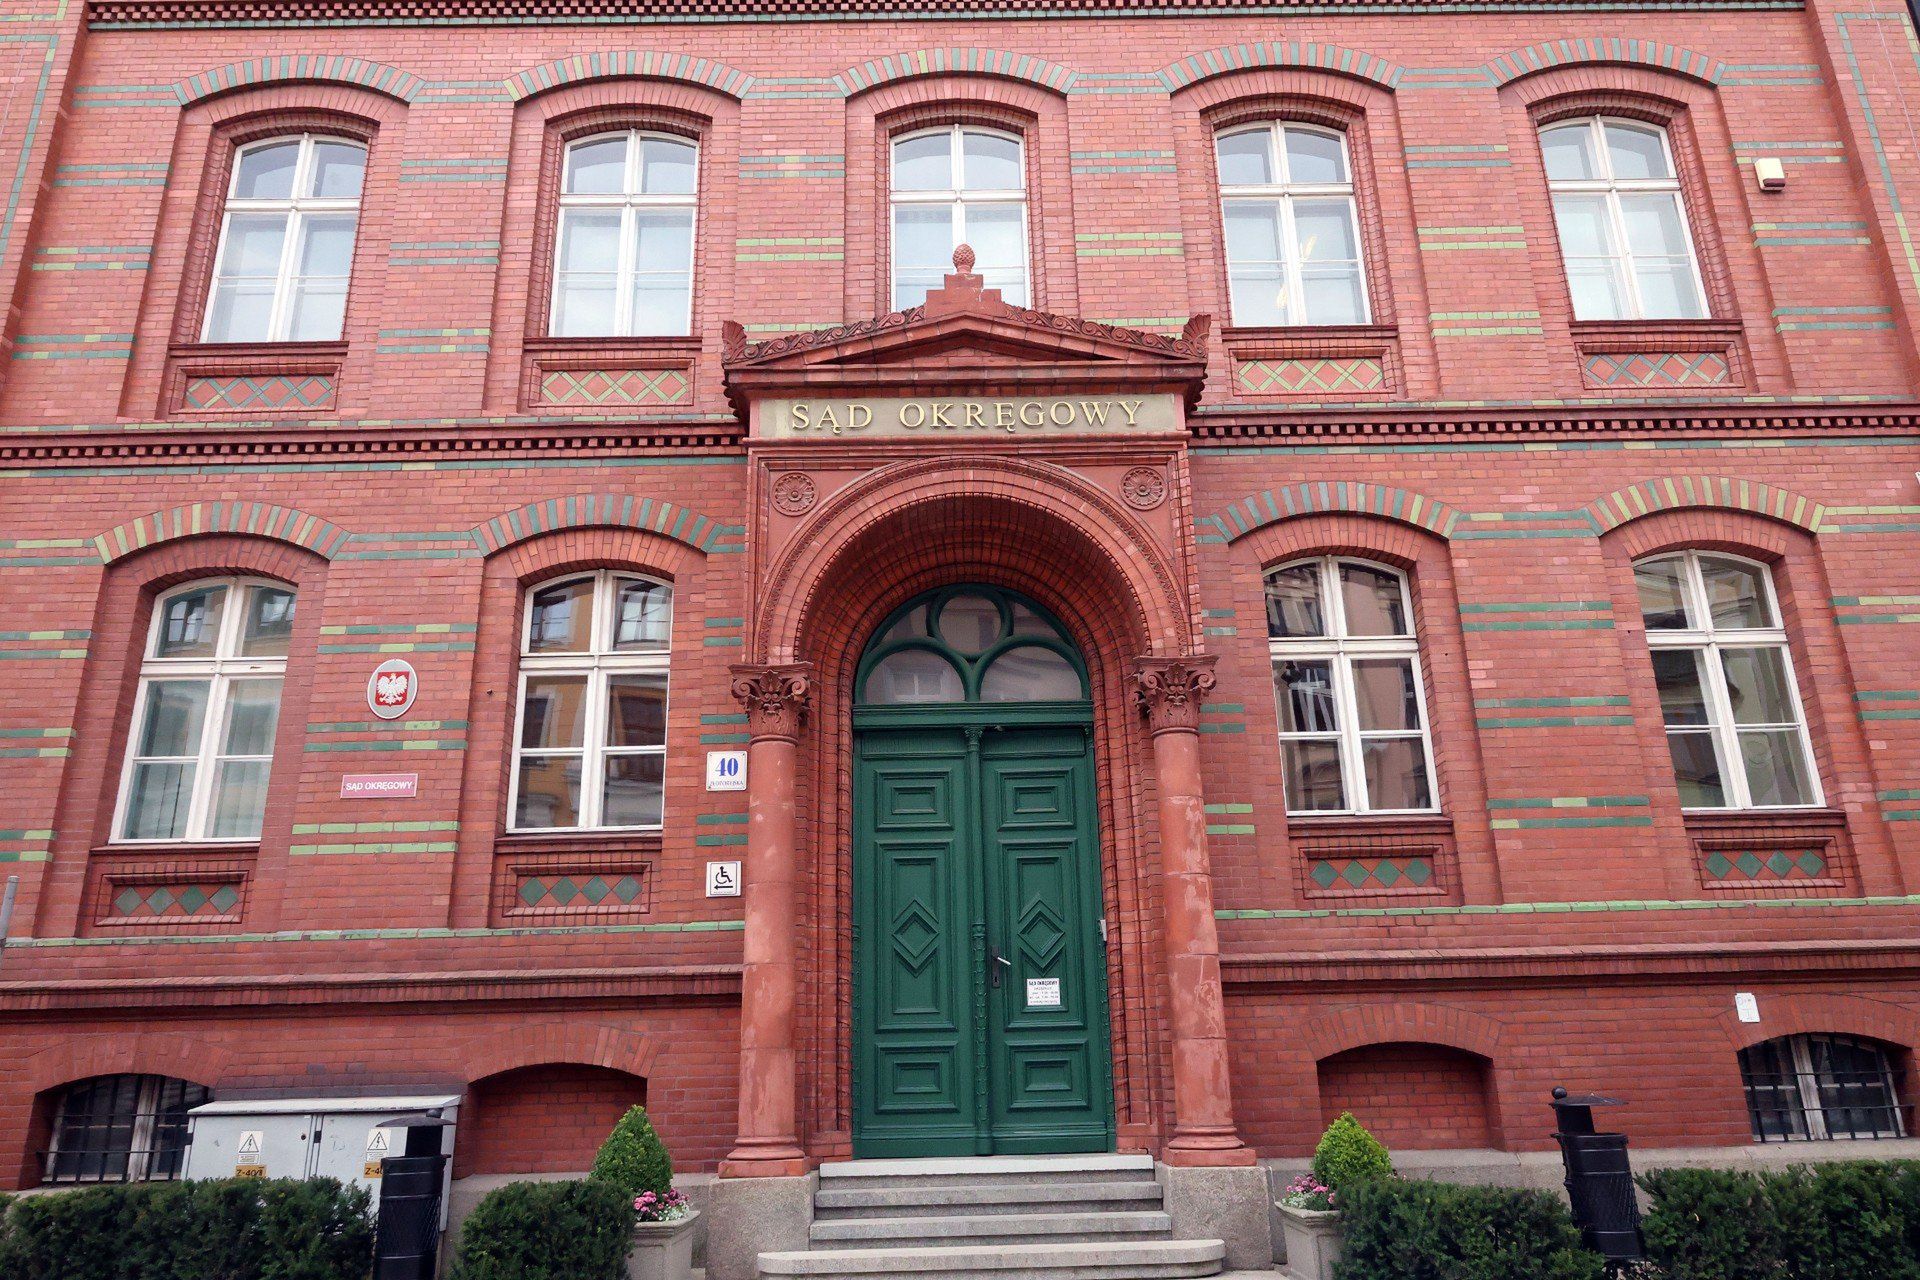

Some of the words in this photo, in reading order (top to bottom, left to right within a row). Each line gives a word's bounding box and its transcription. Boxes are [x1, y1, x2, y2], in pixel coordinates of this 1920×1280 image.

[791, 403, 874, 434] SĄD
[899, 400, 1144, 432] OKRĘGOWY
[715, 757, 739, 777] 40
[346, 782, 363, 792] SĄD
[364, 781, 413, 792] OKRĘGOWY
